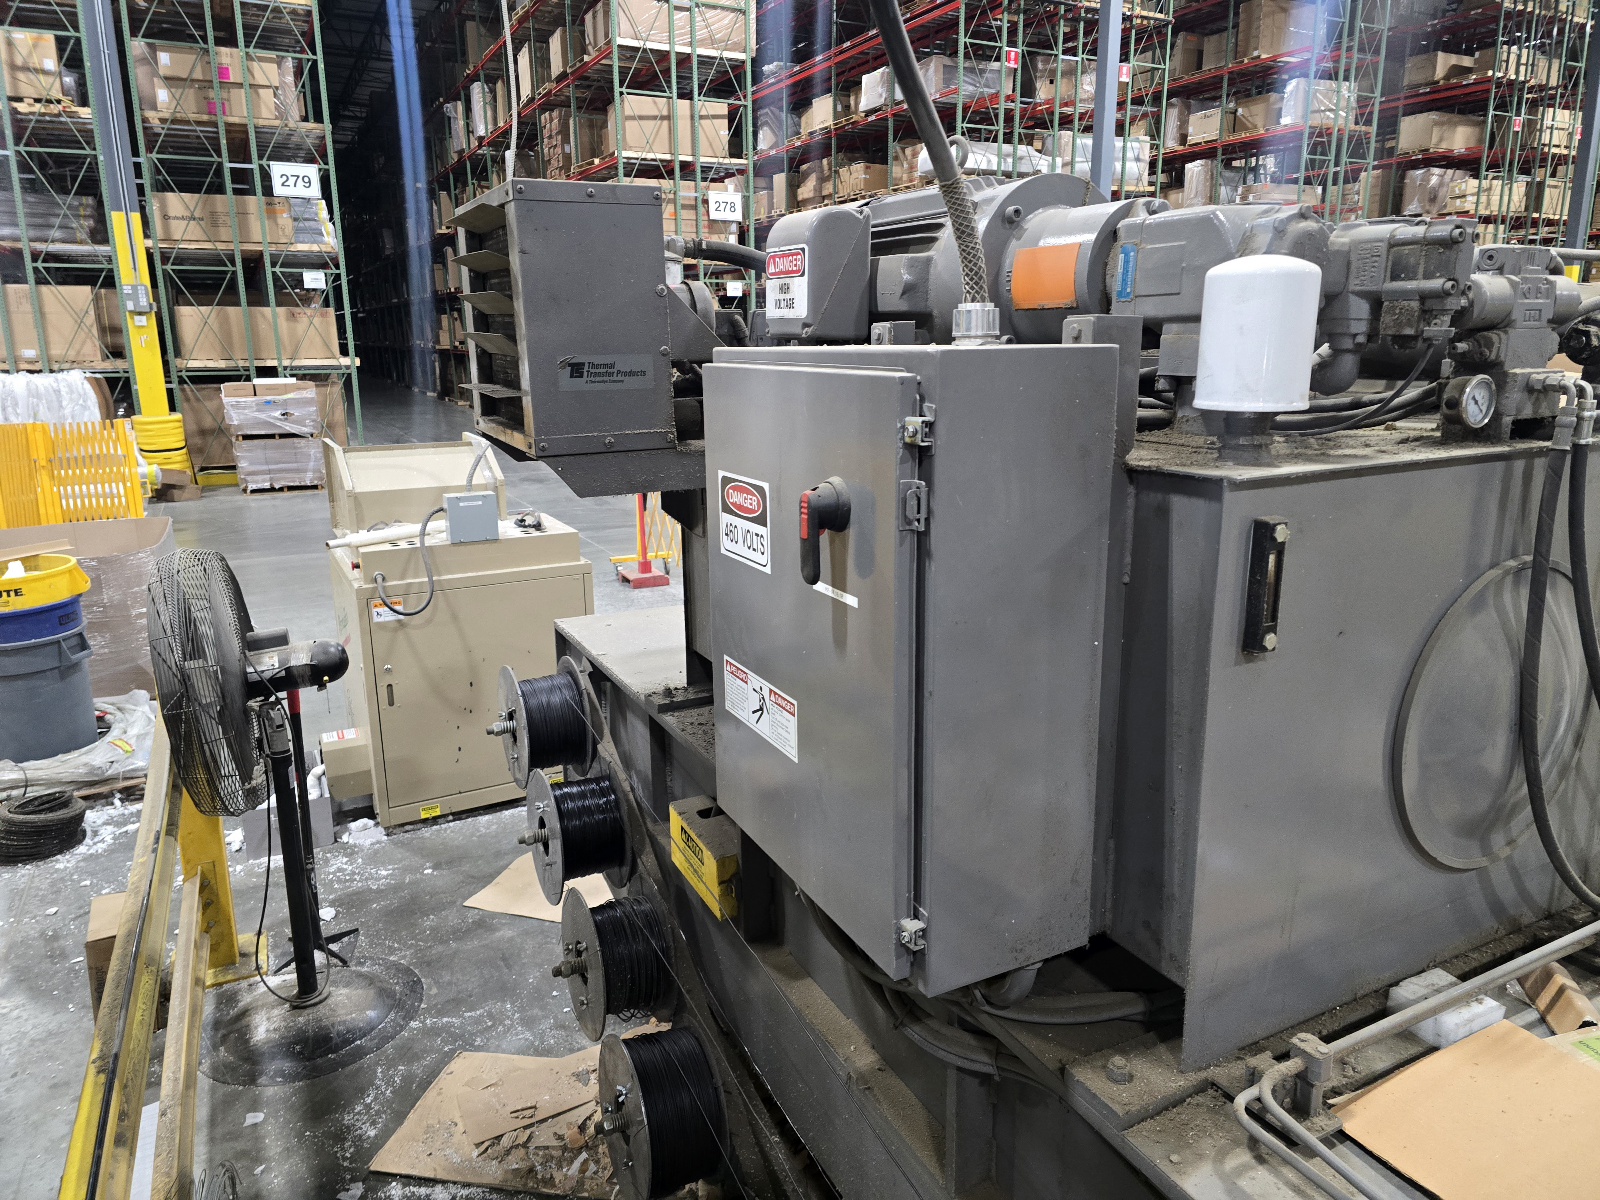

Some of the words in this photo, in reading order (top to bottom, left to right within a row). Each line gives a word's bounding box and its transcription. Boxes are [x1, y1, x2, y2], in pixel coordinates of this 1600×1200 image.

[280, 173, 312, 189] 279
[714, 200, 736, 213] 278
[775, 255, 802, 272] DANGER
[779, 283, 790, 294] HIGH
[774, 298, 795, 310] VOLTAGE
[586, 370, 614, 378] Transfer
[616, 369, 647, 378] Products
[587, 361, 615, 370] Thermal
[728, 489, 758, 511] DANGER
[725, 522, 739, 545] 460
[741, 527, 765, 556] VOLTS
[730, 665, 748, 682] PELIGRO
[775, 695, 794, 714] DANGER
